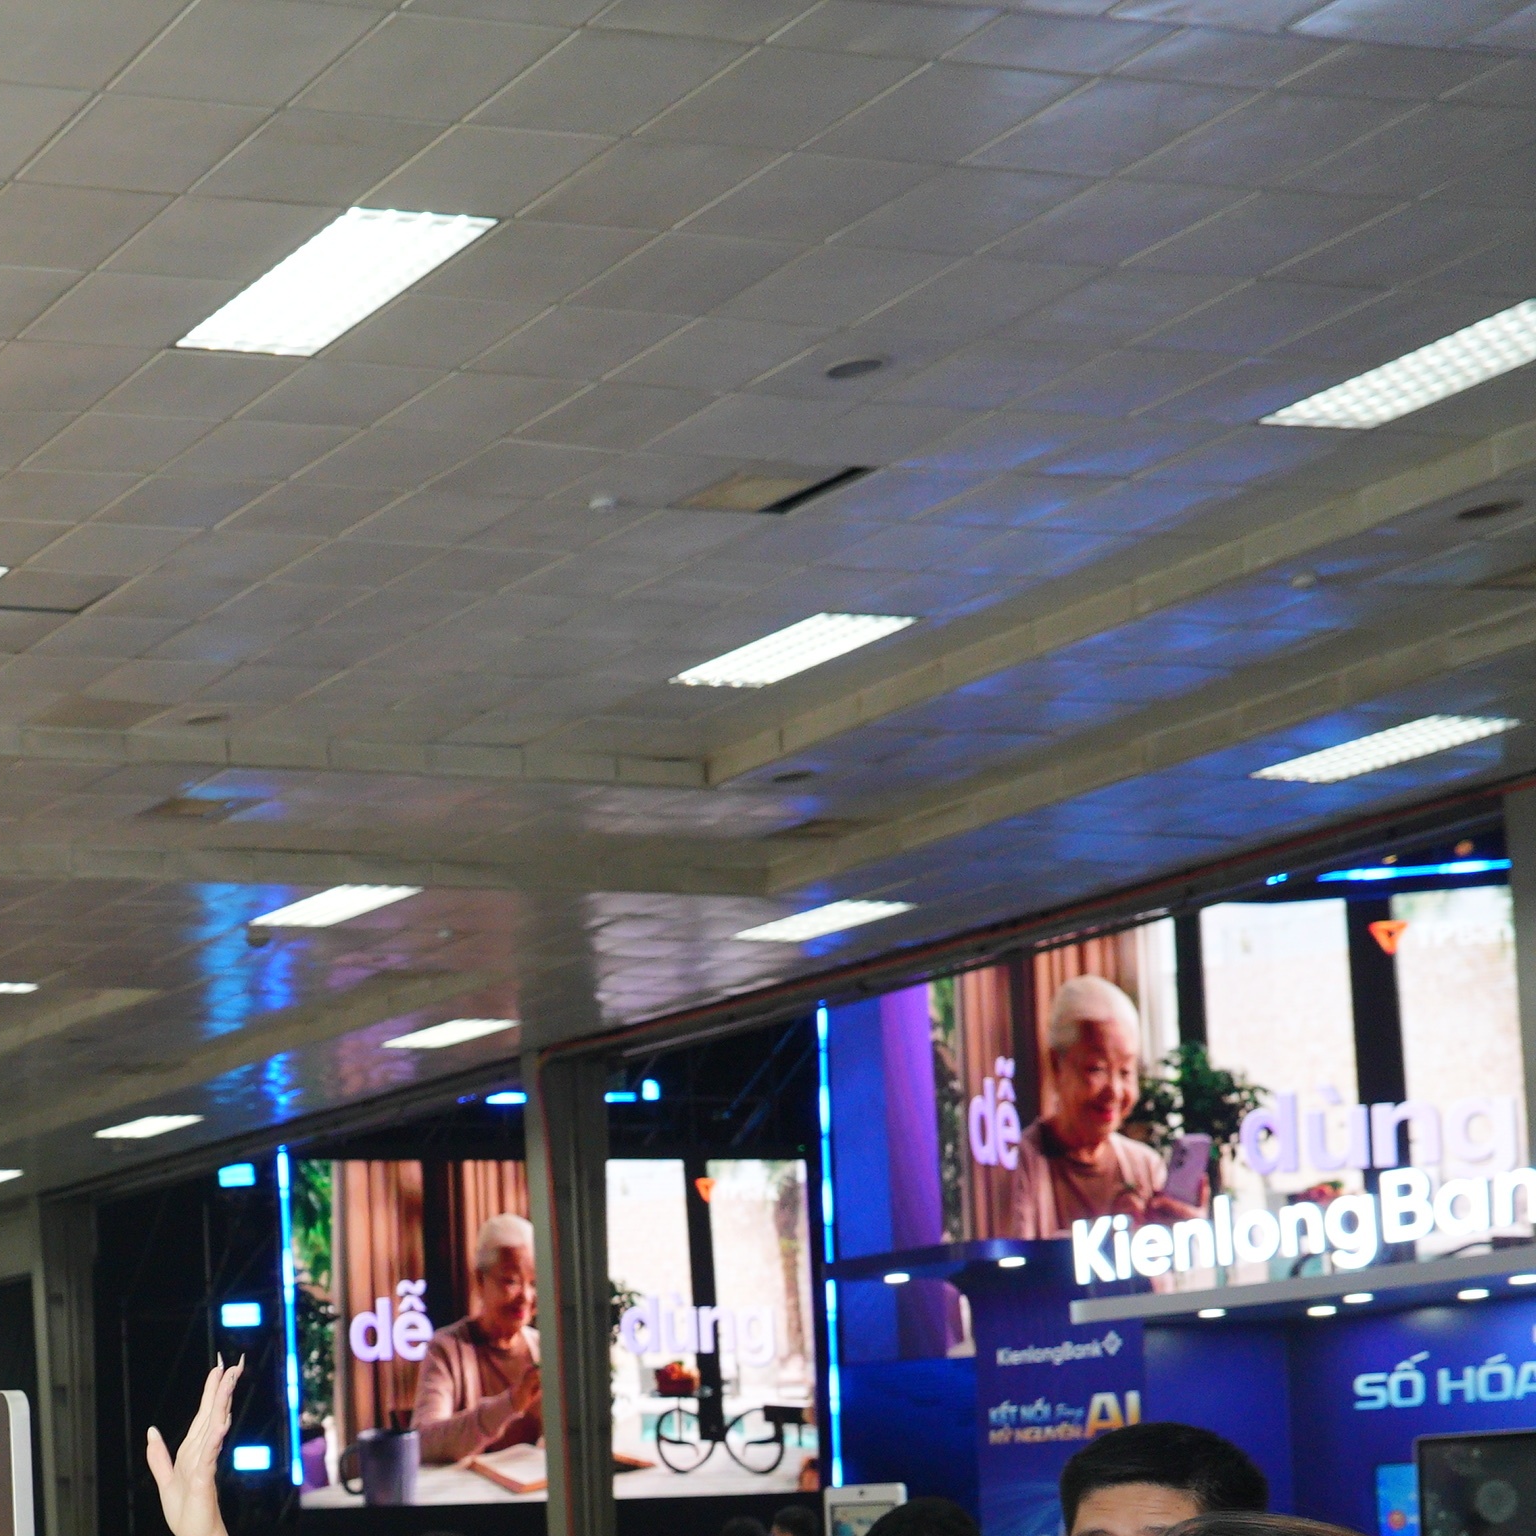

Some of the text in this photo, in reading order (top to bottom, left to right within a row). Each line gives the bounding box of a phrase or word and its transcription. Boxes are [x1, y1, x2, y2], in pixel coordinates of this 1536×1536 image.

[969, 1056, 1518, 1178] dễ dùng
[1072, 1167, 1536, 1285] KienlongBan
[350, 1279, 775, 1365] dễ dùng
[1085, 1390, 1141, 1439] AI
[1353, 1351, 1430, 1410] SỐ
